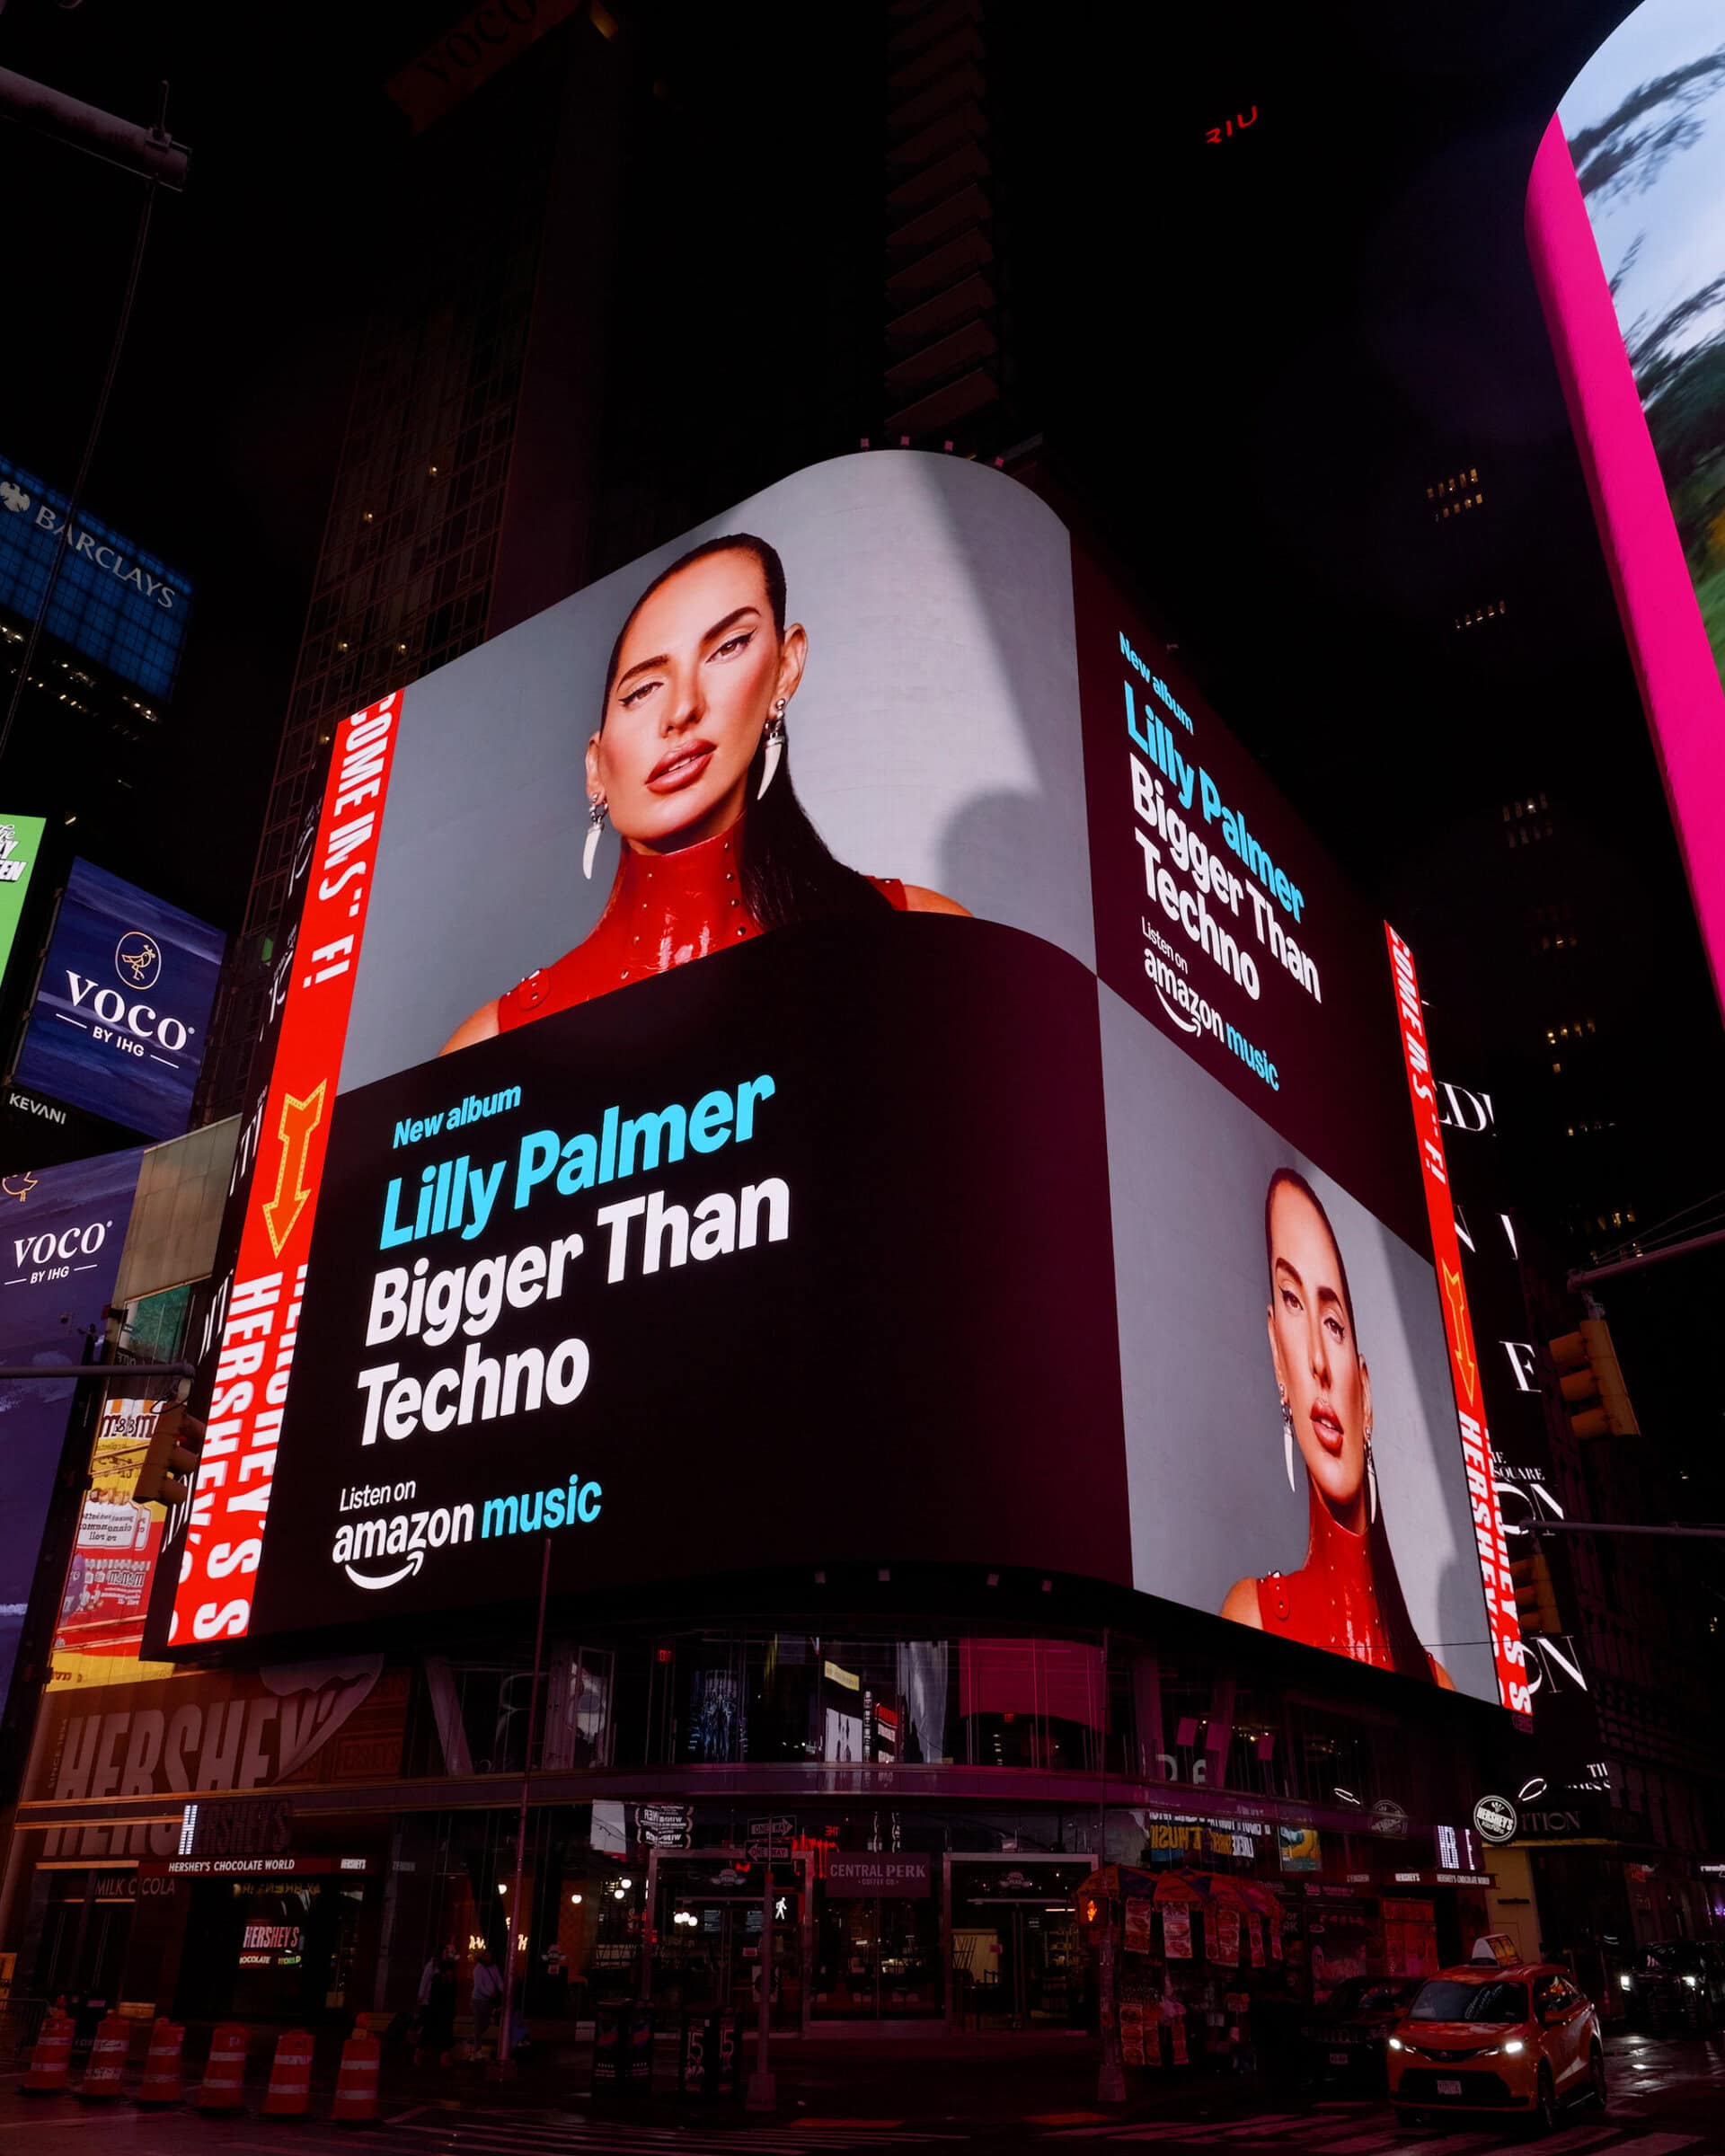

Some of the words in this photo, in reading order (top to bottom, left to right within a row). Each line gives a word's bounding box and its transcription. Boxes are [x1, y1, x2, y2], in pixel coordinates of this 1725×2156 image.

[34, 505, 175, 609] BARCLAYS
[1119, 632, 1150, 683] New
[1152, 674, 1193, 735] album
[1124, 680, 1195, 809] Lilly
[1199, 766, 1305, 923] Palmer
[1128, 751, 1243, 916] Bigger
[1246, 880, 1322, 1004] Than
[1135, 826, 1260, 1001] Techno
[1142, 916, 1175, 963] Listen
[1174, 951, 1188, 975] on
[66, 970, 188, 1051] VOCO
[93, 1025, 111, 1044] BY
[117, 1037, 145, 1057] IHG
[1144, 948, 1225, 1043] amazon
[1225, 1021, 1280, 1091] music
[9, 1092, 66, 1126] KEVANI
[393, 1117, 444, 1149] New
[447, 1085, 522, 1131] album
[379, 1154, 508, 1250] Lilly
[514, 1074, 776, 1210] Palmer
[13, 1223, 106, 1268] VOCO
[30, 1269, 46, 1286] BY
[47, 1265, 69, 1281] IHG
[365, 1233, 584, 1348] Bigger
[597, 1177, 791, 1284] Than
[357, 1338, 590, 1446] Techno
[332, 1502, 474, 1565] amazon
[481, 1473, 603, 1539] music
[340, 1484, 391, 1512] Listen
[394, 1480, 417, 1501] on
[94, 1877, 125, 1896] MILK
[168, 1861, 211, 1872] HERSHEY'S
[214, 1860, 264, 1872] CHOCOLATE
[264, 1859, 295, 1870] WORLD
[830, 1864, 883, 1878] CENTRAL
[886, 1864, 927, 1878] PERK
